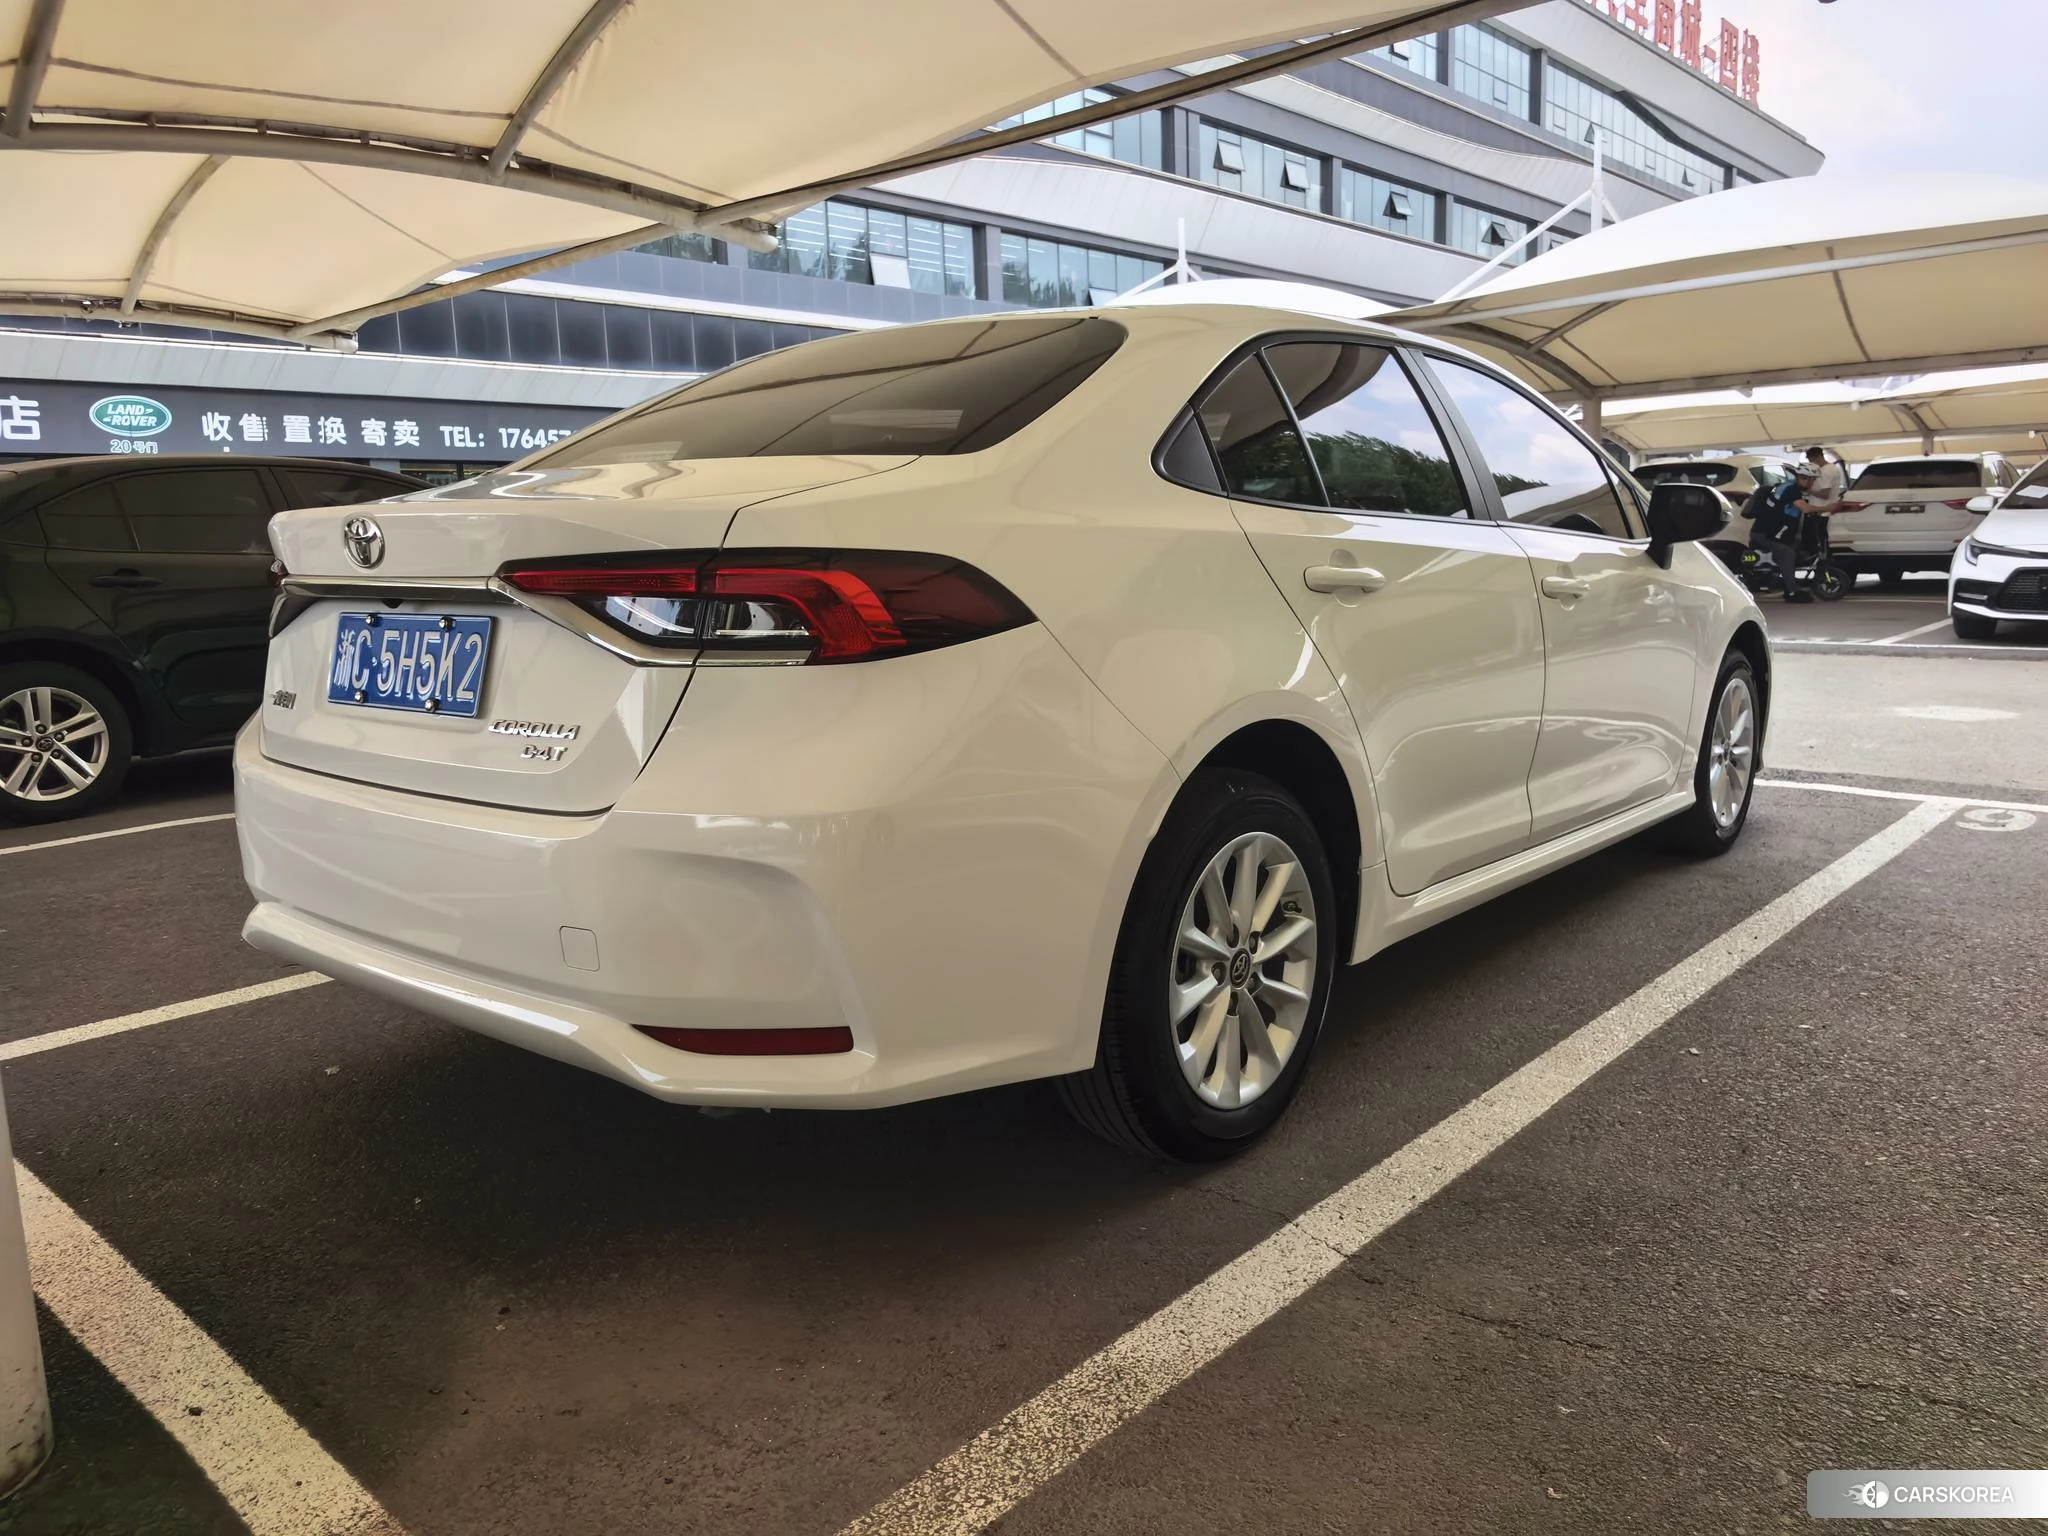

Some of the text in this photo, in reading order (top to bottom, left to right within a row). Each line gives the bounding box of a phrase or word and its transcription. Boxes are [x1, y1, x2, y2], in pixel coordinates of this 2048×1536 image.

[0, 395, 41, 440] 店
[107, 403, 145, 416] LAND
[111, 414, 157, 427] ROVER
[488, 719, 581, 740] COROLLA
